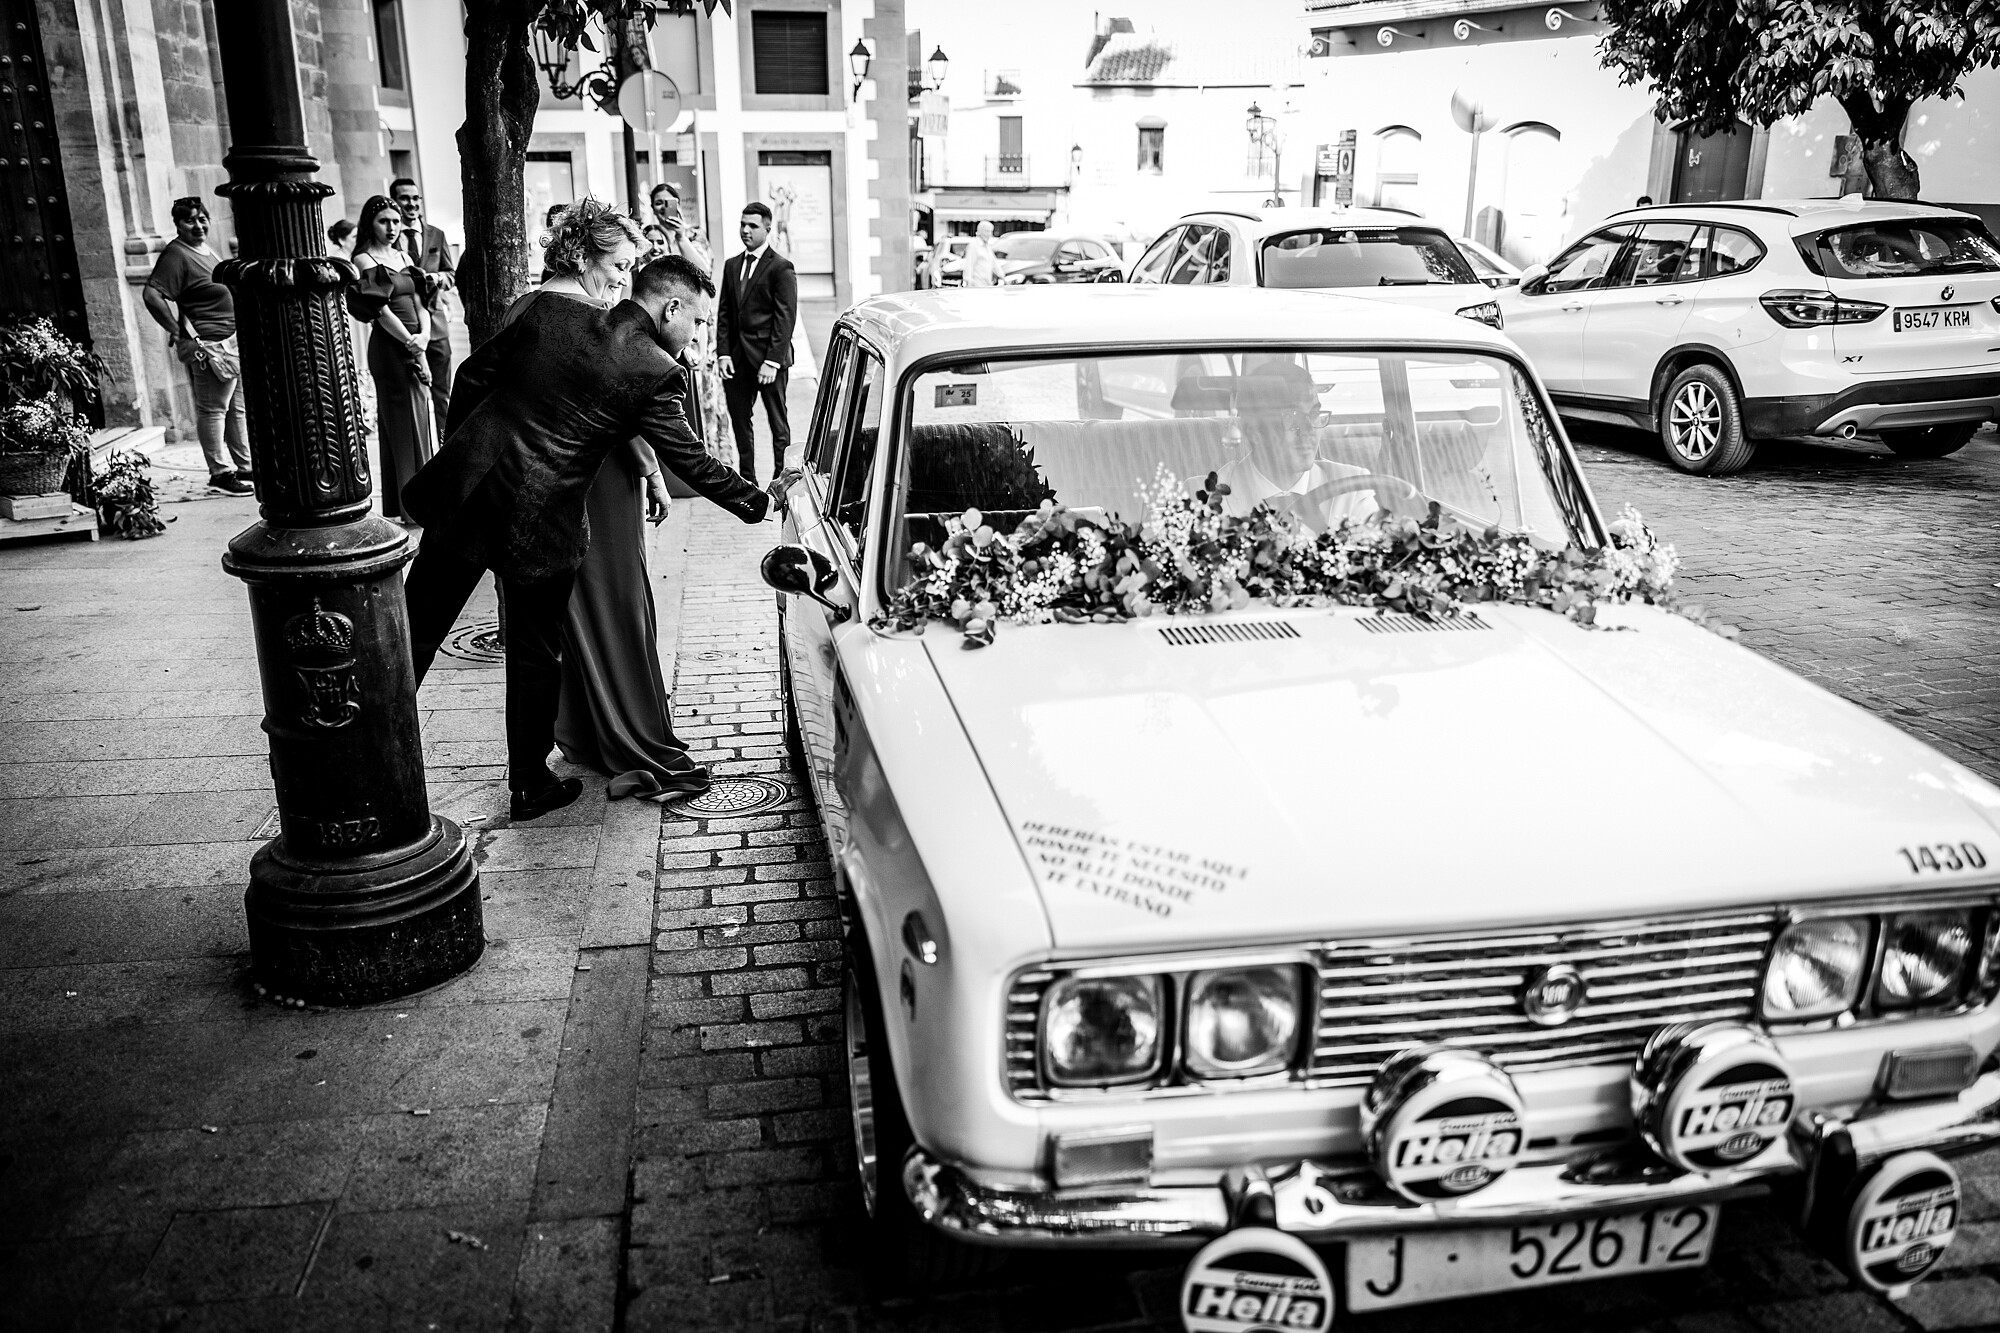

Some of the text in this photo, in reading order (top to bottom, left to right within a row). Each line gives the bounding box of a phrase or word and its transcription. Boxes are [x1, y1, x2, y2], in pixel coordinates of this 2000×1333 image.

[1904, 310, 1970, 329] 9547 KRM
[1841, 355, 1863, 363] X1
[317, 816, 382, 846] 1832
[1897, 842, 1987, 874] 1430
[1683, 1098, 1787, 1136] Hella
[1400, 1131, 1518, 1166] Hella
[1866, 1205, 1953, 1250] Hella
[1366, 1205, 1708, 1298] J 52612
[1194, 1286, 1319, 1326] Hella
